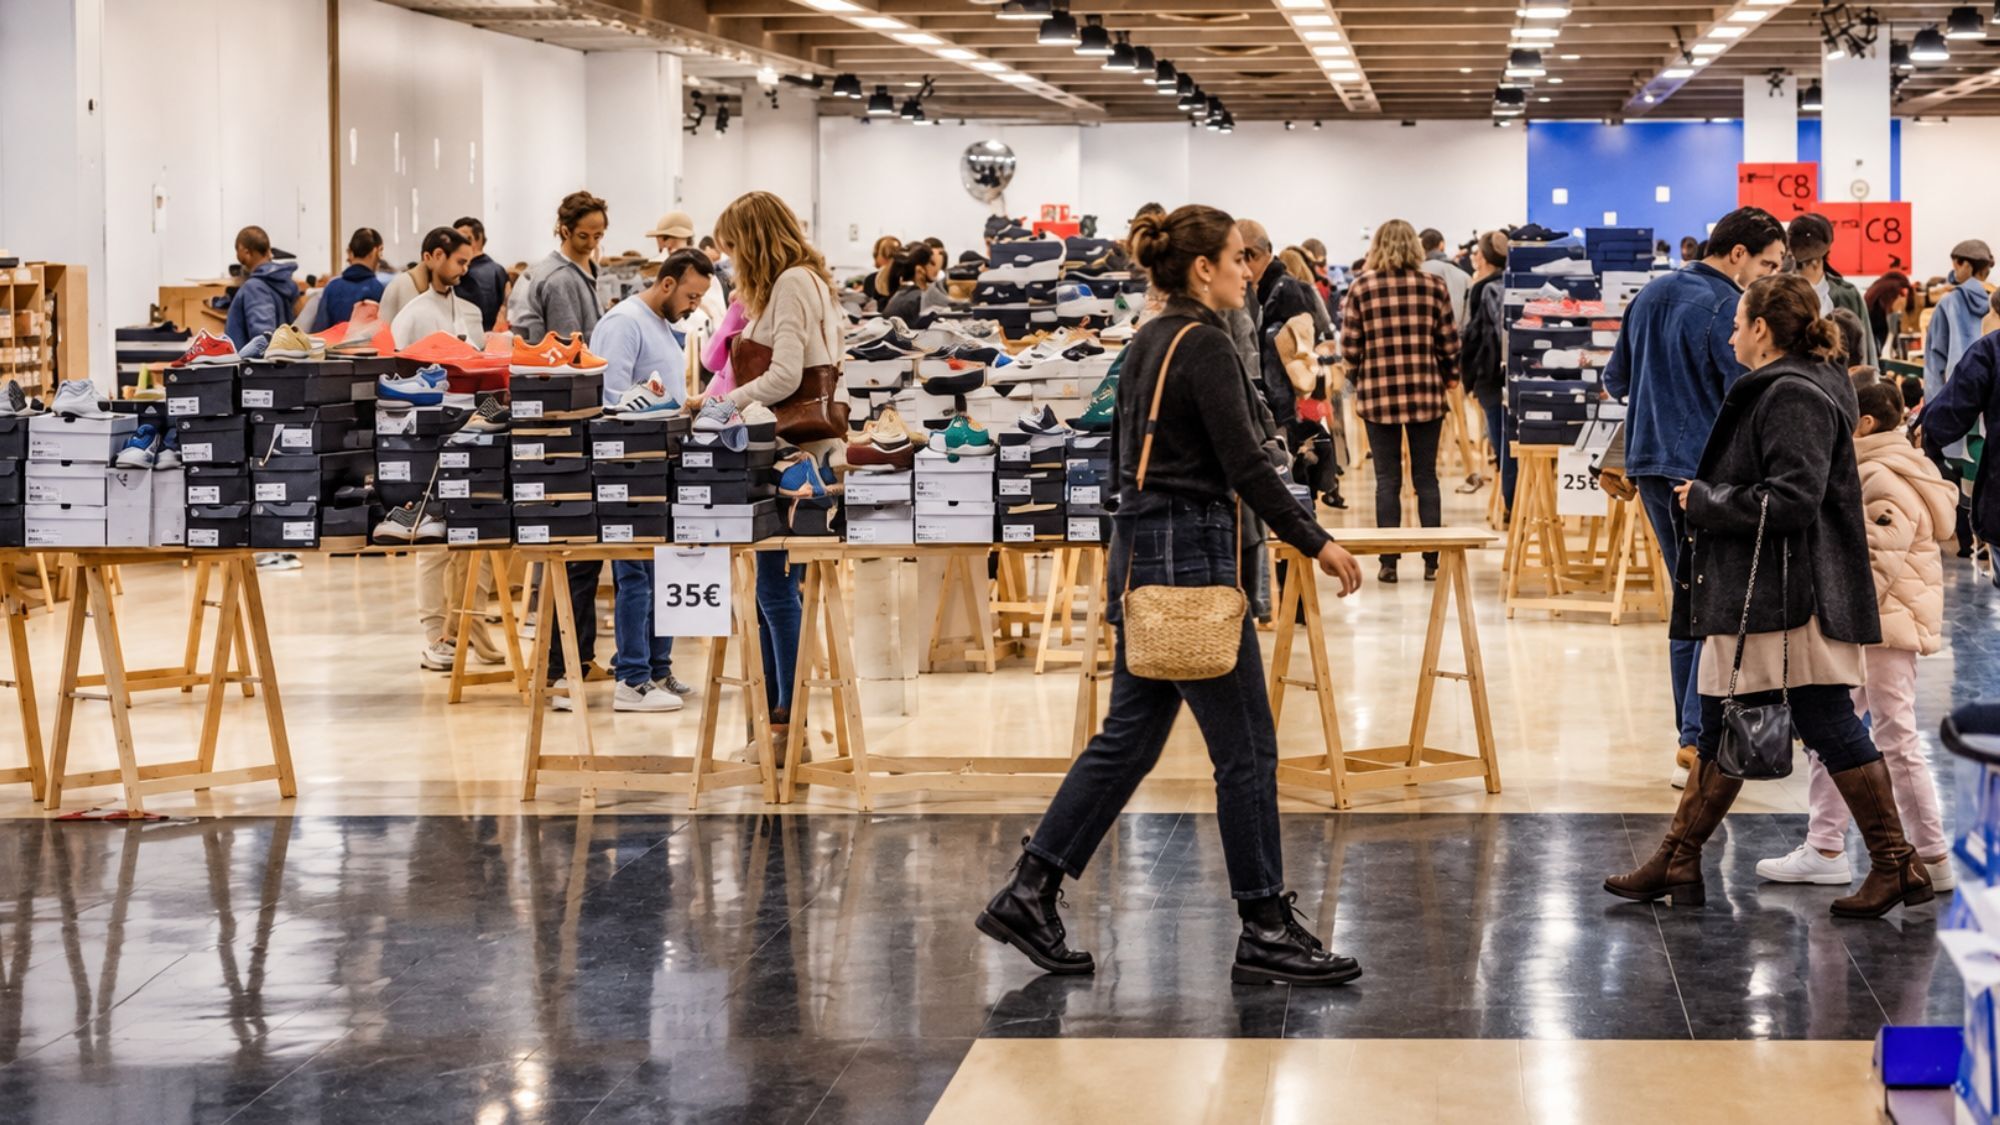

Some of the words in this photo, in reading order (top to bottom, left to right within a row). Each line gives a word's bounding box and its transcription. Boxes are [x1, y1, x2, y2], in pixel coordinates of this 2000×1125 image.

[1777, 174, 1811, 199] C8
[1865, 217, 1902, 244] C8
[1563, 473, 1600, 491] 25€
[666, 583, 721, 608] 35€
